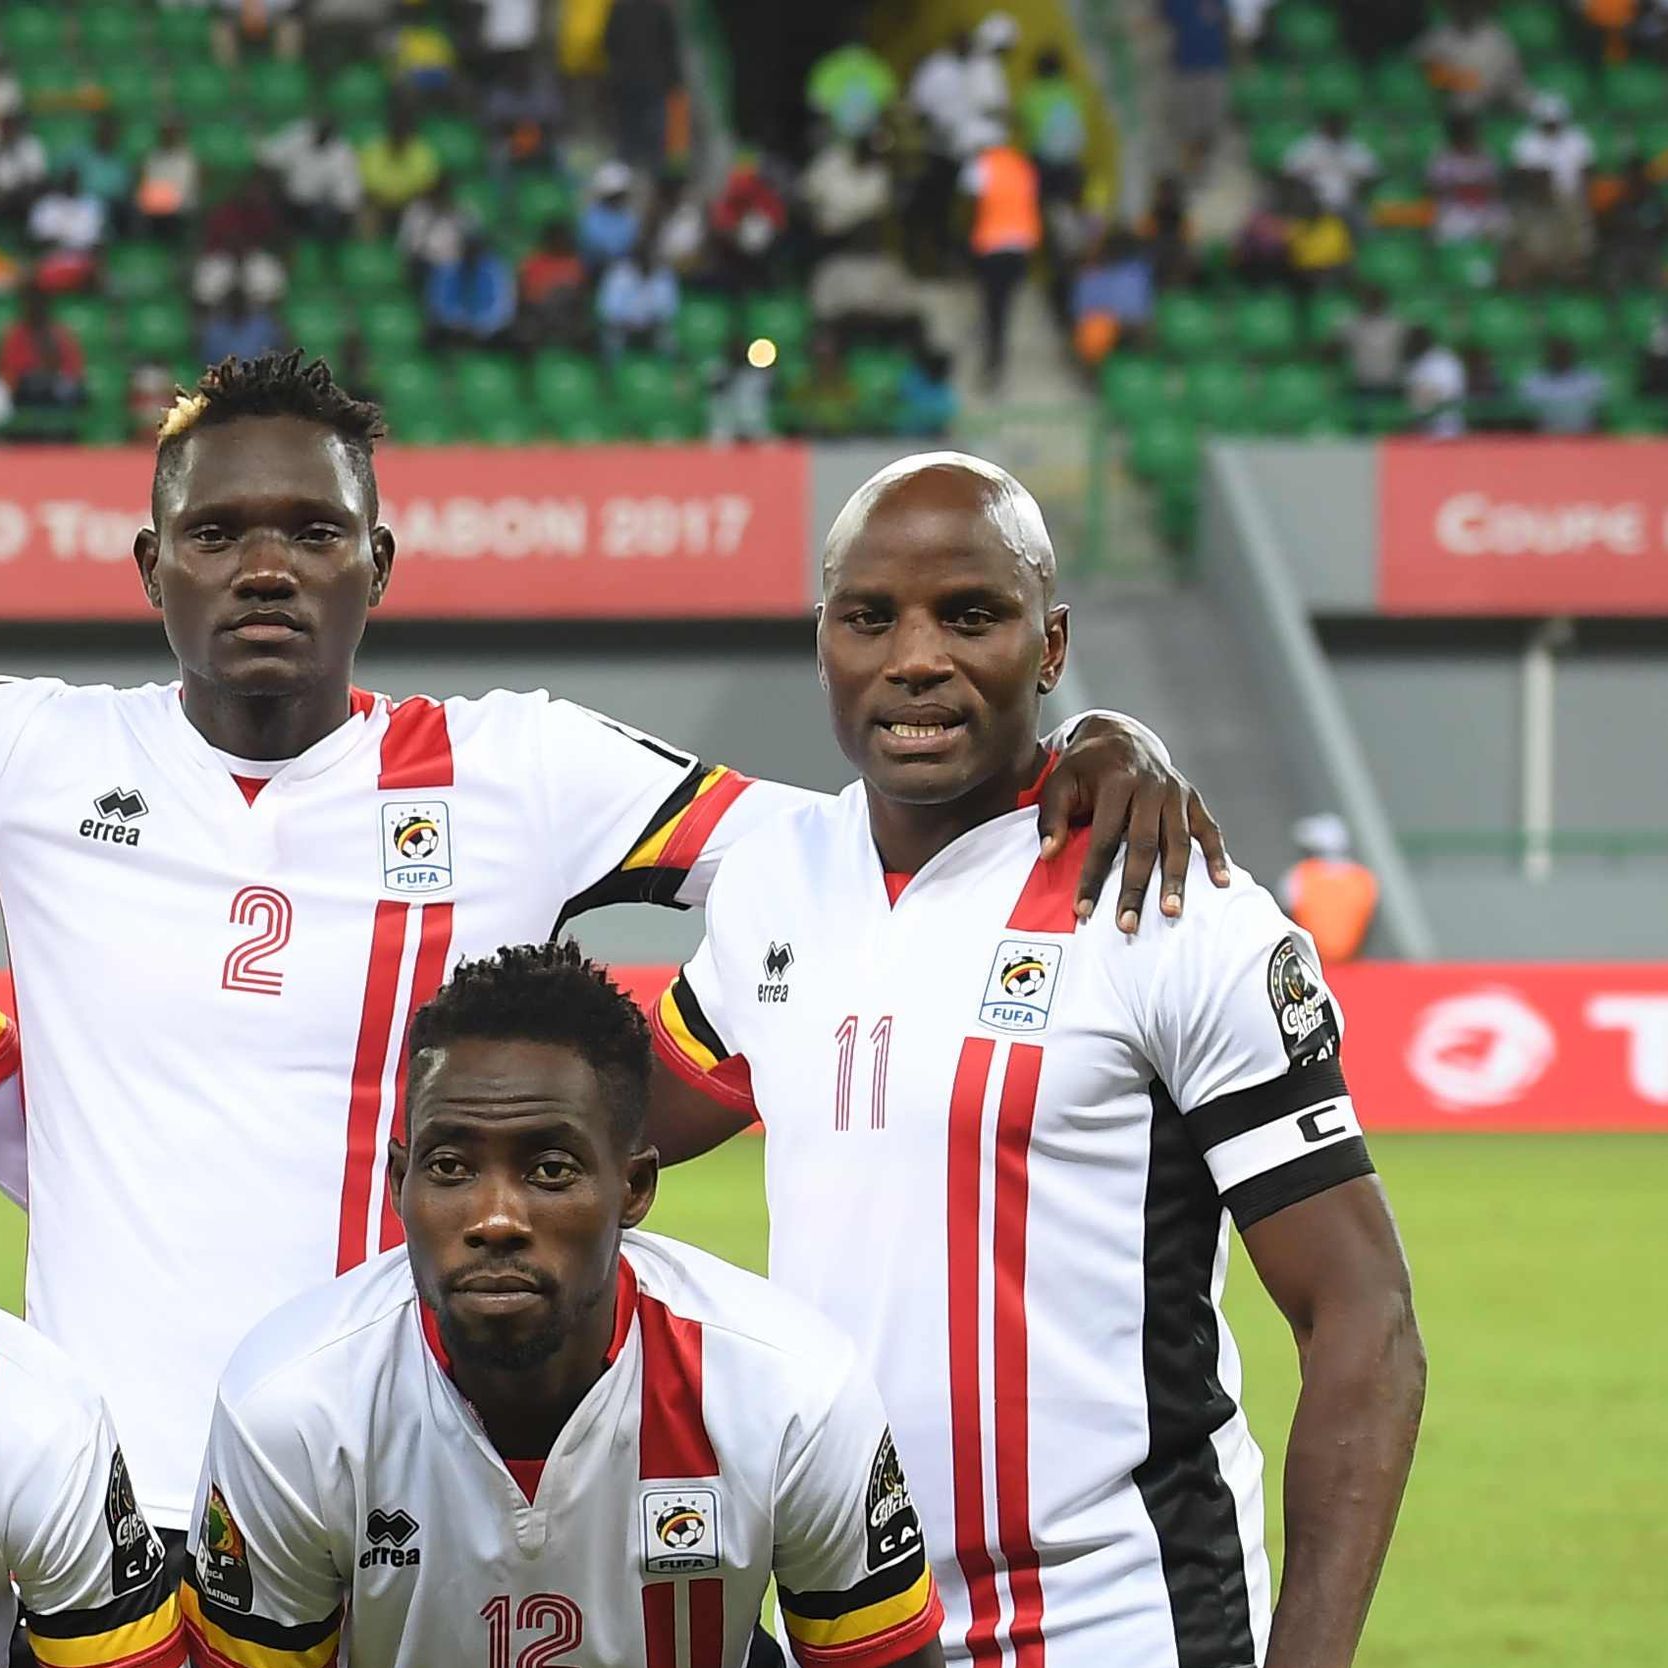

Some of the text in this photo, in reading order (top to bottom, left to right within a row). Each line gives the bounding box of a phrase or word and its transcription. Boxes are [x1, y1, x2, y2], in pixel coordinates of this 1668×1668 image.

[600, 495, 755, 558] 2017
[79, 818, 141, 847] errea
[396, 871, 440, 885] FUFA
[221, 885, 294, 996] 2
[757, 982, 789, 1004] errea
[991, 1007, 1034, 1025] FUFA
[834, 1015, 893, 1132] 11
[1296, 1104, 1347, 1143] C
[358, 1545, 421, 1569] errea
[659, 1558, 705, 1571] FUFA
